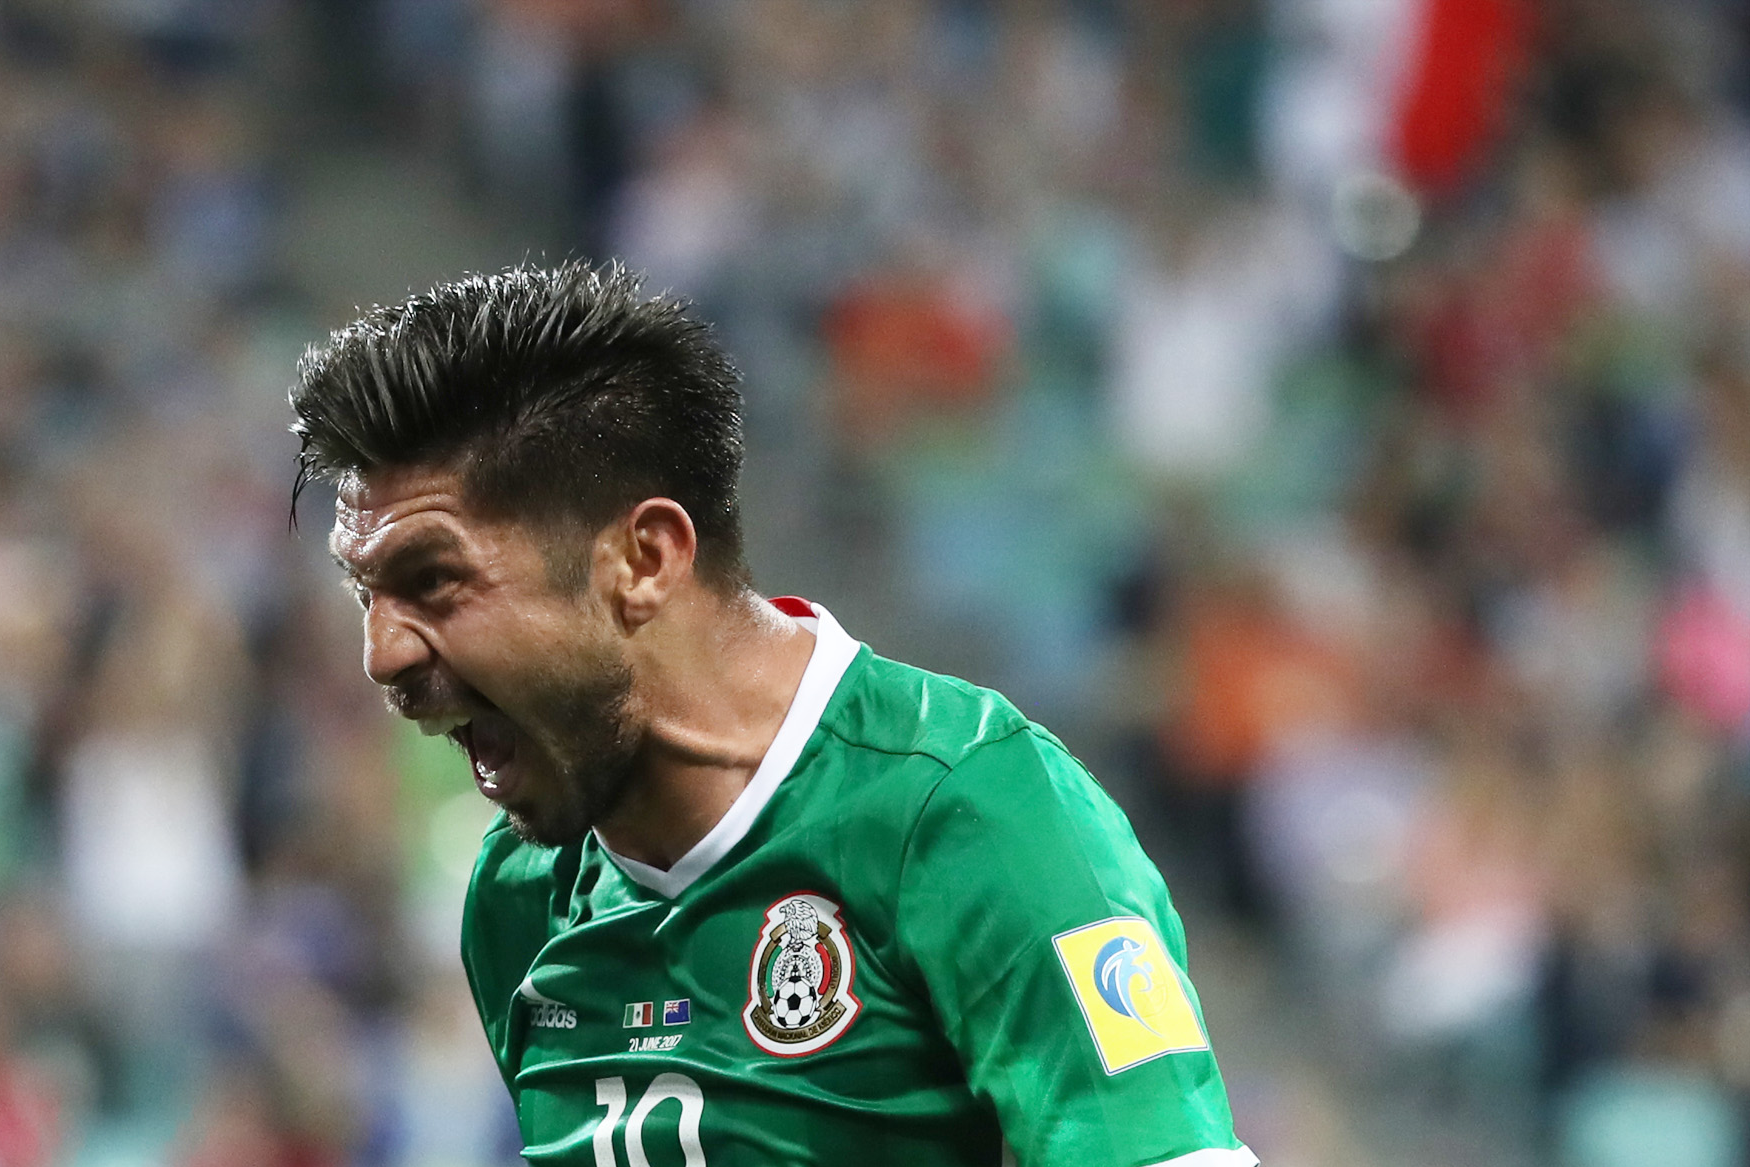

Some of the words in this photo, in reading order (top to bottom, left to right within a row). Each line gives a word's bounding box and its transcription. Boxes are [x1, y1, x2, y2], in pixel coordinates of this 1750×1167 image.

[530, 1003, 578, 1030] adidas
[629, 1037, 640, 1052] 21
[659, 1034, 683, 1048] 2017
